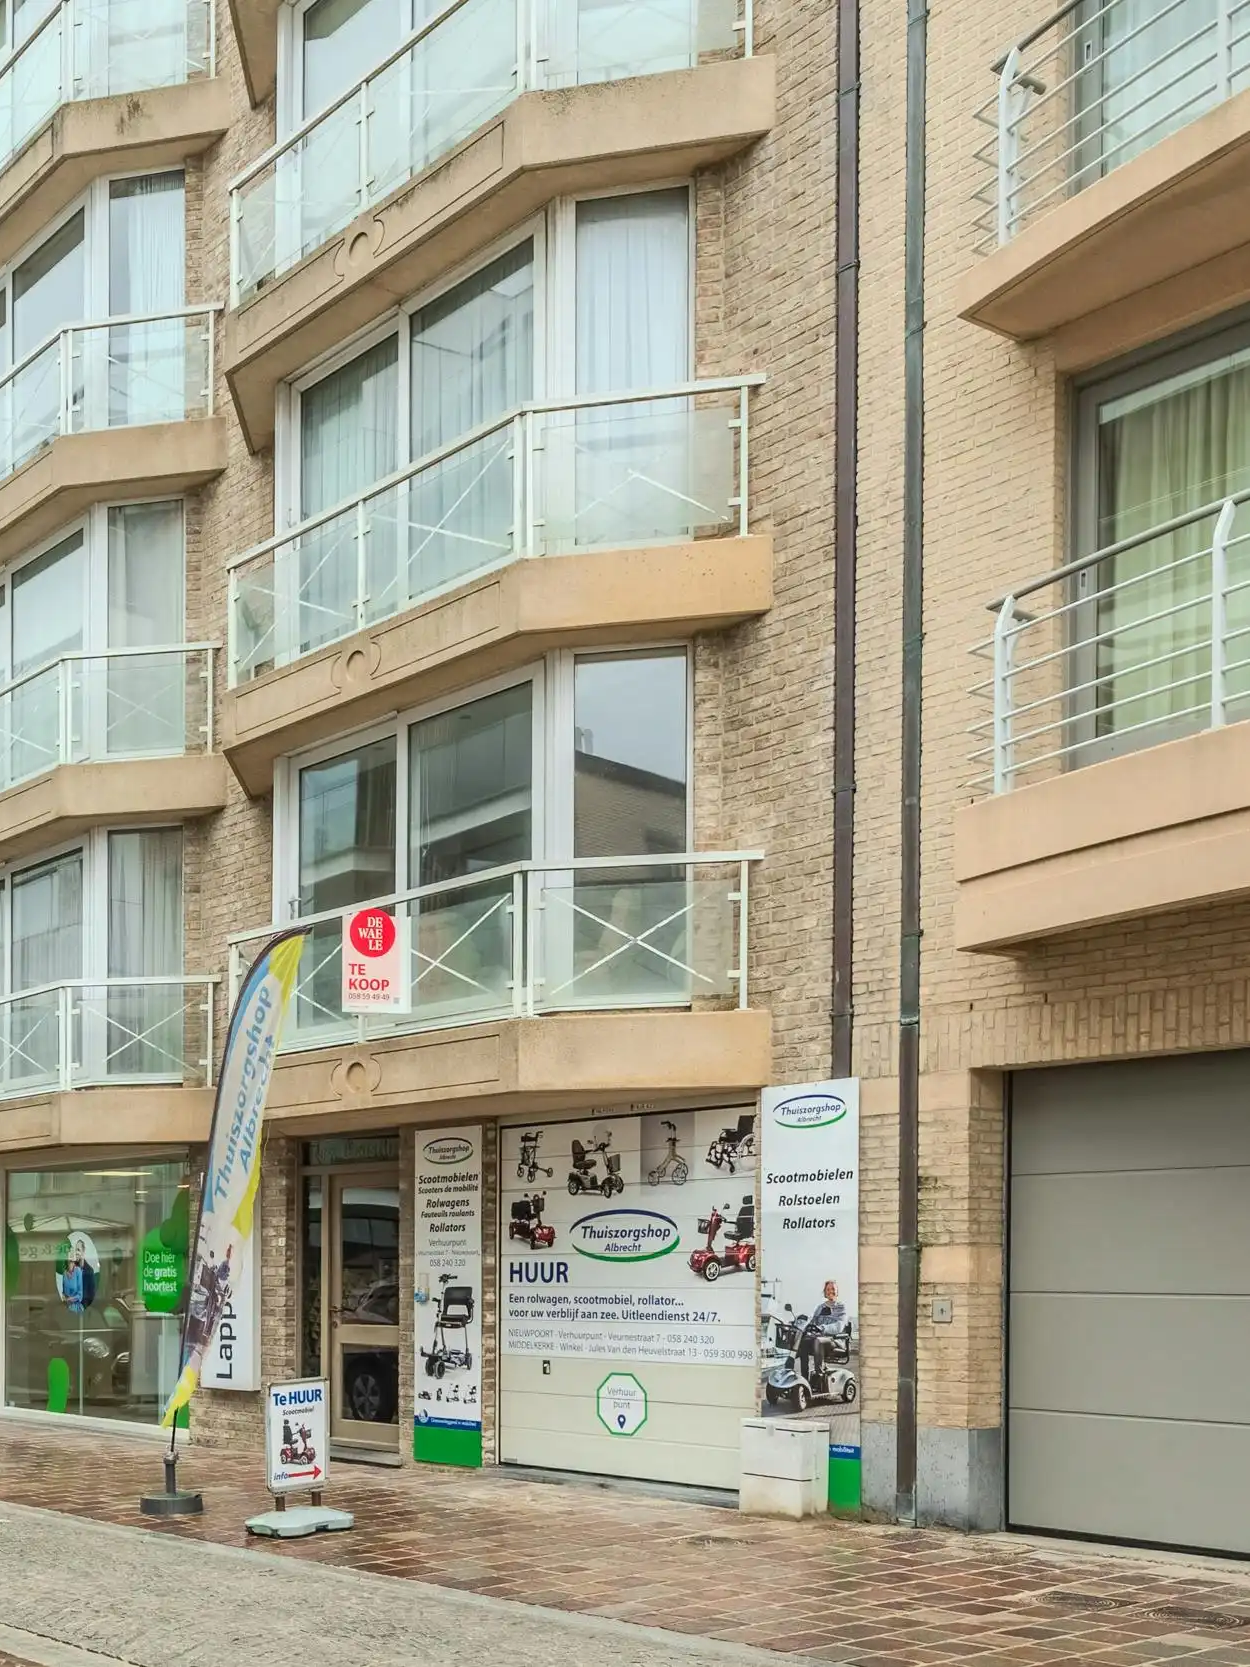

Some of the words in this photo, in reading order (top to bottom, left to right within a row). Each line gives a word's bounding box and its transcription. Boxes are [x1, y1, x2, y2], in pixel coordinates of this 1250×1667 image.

[367, 916, 383, 928] DE
[358, 928, 383, 939] WAE
[368, 939, 383, 950] LE
[348, 963, 366, 976] TE
[349, 978, 390, 991] KOOP
[214, 985, 271, 1199] Thuiszorgshop
[239, 1034, 276, 1175] Albrecht
[781, 1103, 841, 1116] Thuiszorgshop
[418, 1172, 479, 1184] Scootmobielen
[766, 1168, 854, 1184] Scootmobielen
[418, 1186, 443, 1194] Scooters
[426, 1198, 470, 1210] Rolwagens
[778, 1193, 840, 1207] Rolstoelen
[421, 1210, 448, 1218] Fauteuils
[430, 1223, 466, 1232] Rollators
[782, 1217, 836, 1229] Rollators
[581, 1224, 671, 1241] Thuiszorgshop
[604, 1243, 641, 1252] Albrecht
[145, 1251, 160, 1263] Doe
[430, 1259, 440, 1267] 058
[143, 1265, 153, 1277] de
[154, 1265, 177, 1280] gratis
[509, 1262, 569, 1283] HUUR
[143, 1280, 177, 1292] hoortest
[509, 1293, 525, 1303] Een
[527, 1293, 571, 1306] rolwagen,
[574, 1294, 635, 1306] scootmobiel,
[638, 1295, 684, 1306] rollator...
[509, 1309, 529, 1318] voor
[531, 1310, 544, 1318] uw
[546, 1308, 579, 1321] verblijf
[600, 1312, 619, 1320] zee.
[622, 1310, 690, 1322] Uitleendienst
[692, 1312, 721, 1322] 24/7.
[509, 1329, 553, 1338] NIEUWPOORT
[558, 1330, 603, 1341] Verhuurpunt
[668, 1334, 682, 1343] 058
[684, 1335, 698, 1344] 240
[699, 1336, 715, 1345] 320
[509, 1341, 554, 1350] MIDDELKERKE
[560, 1343, 584, 1352] Winkel
[588, 1344, 606, 1354] Jules
[608, 1345, 621, 1353] Van
[622, 1345, 637, 1354] den
[638, 1346, 686, 1356] Heuvelstraat
[688, 1347, 697, 1357] 13
[703, 1349, 719, 1358] 059
[720, 1349, 736, 1358] 300
[738, 1350, 754, 1360] 998
[607, 1386, 637, 1396] Verhuur
[273, 1393, 286, 1406] Te
[289, 1389, 322, 1404] HUUR
[613, 1401, 631, 1409] punt
[273, 1471, 290, 1481] info
